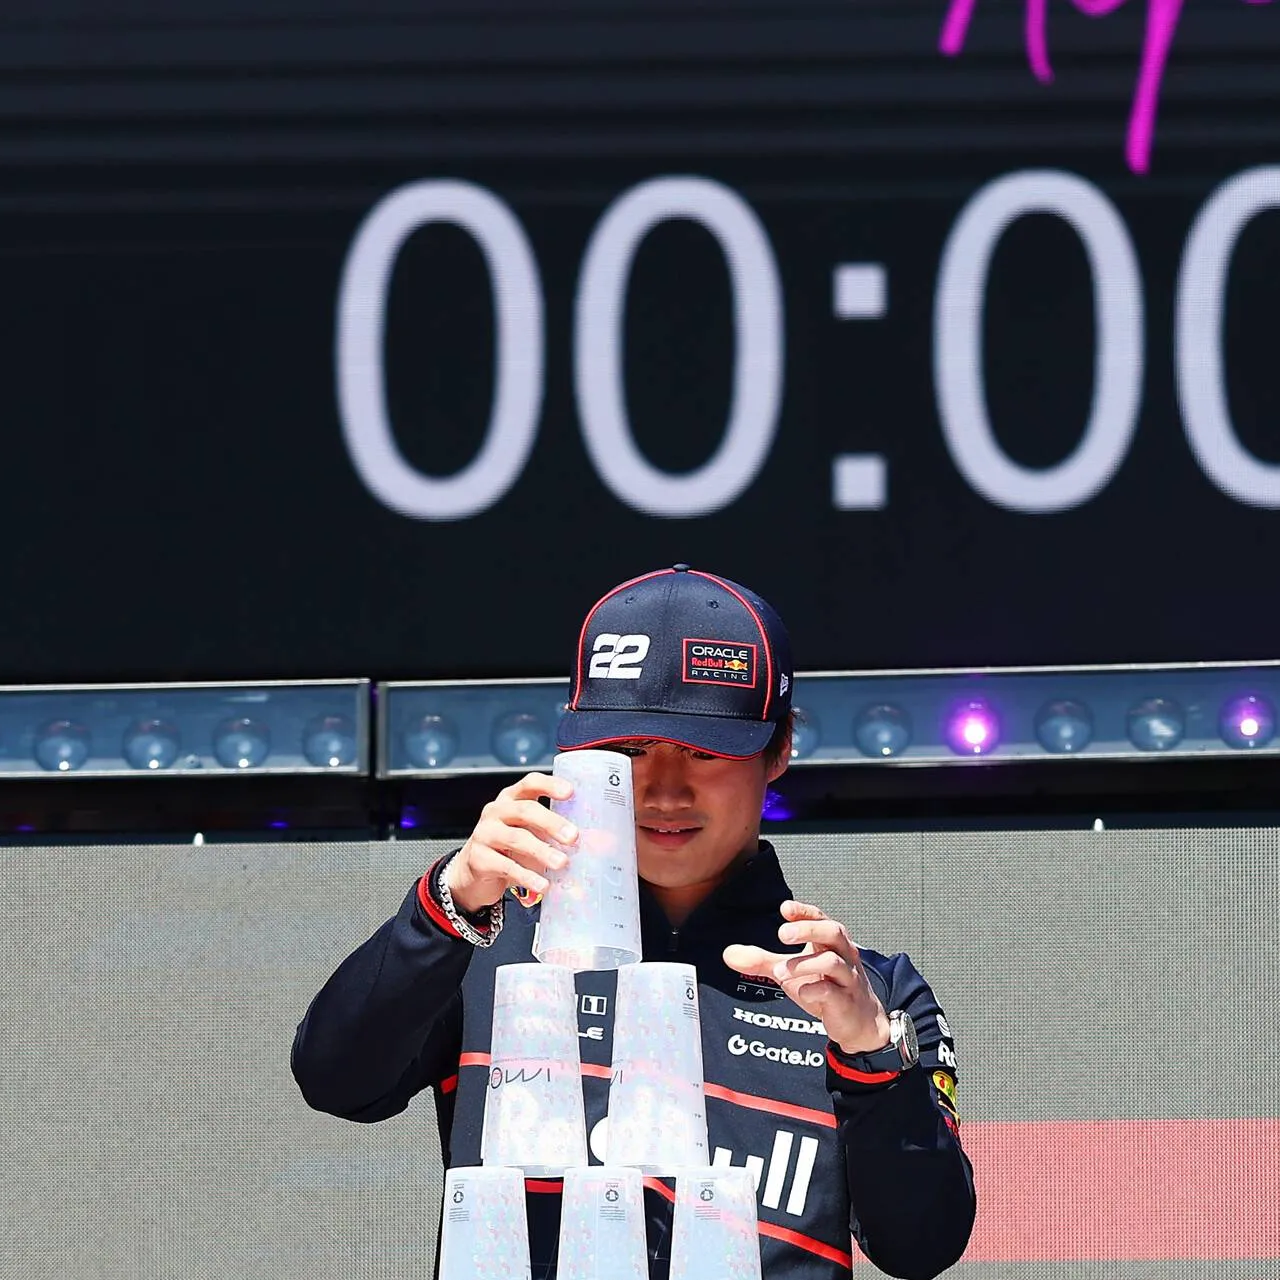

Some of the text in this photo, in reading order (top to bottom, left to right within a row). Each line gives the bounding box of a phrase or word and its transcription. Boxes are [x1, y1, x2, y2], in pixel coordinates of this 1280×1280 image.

[588, 633, 651, 680] 22
[691, 646, 748, 660] ORACLE
[691, 670, 748, 681] RACING
[748, 1041, 825, 1068] Gate.io
